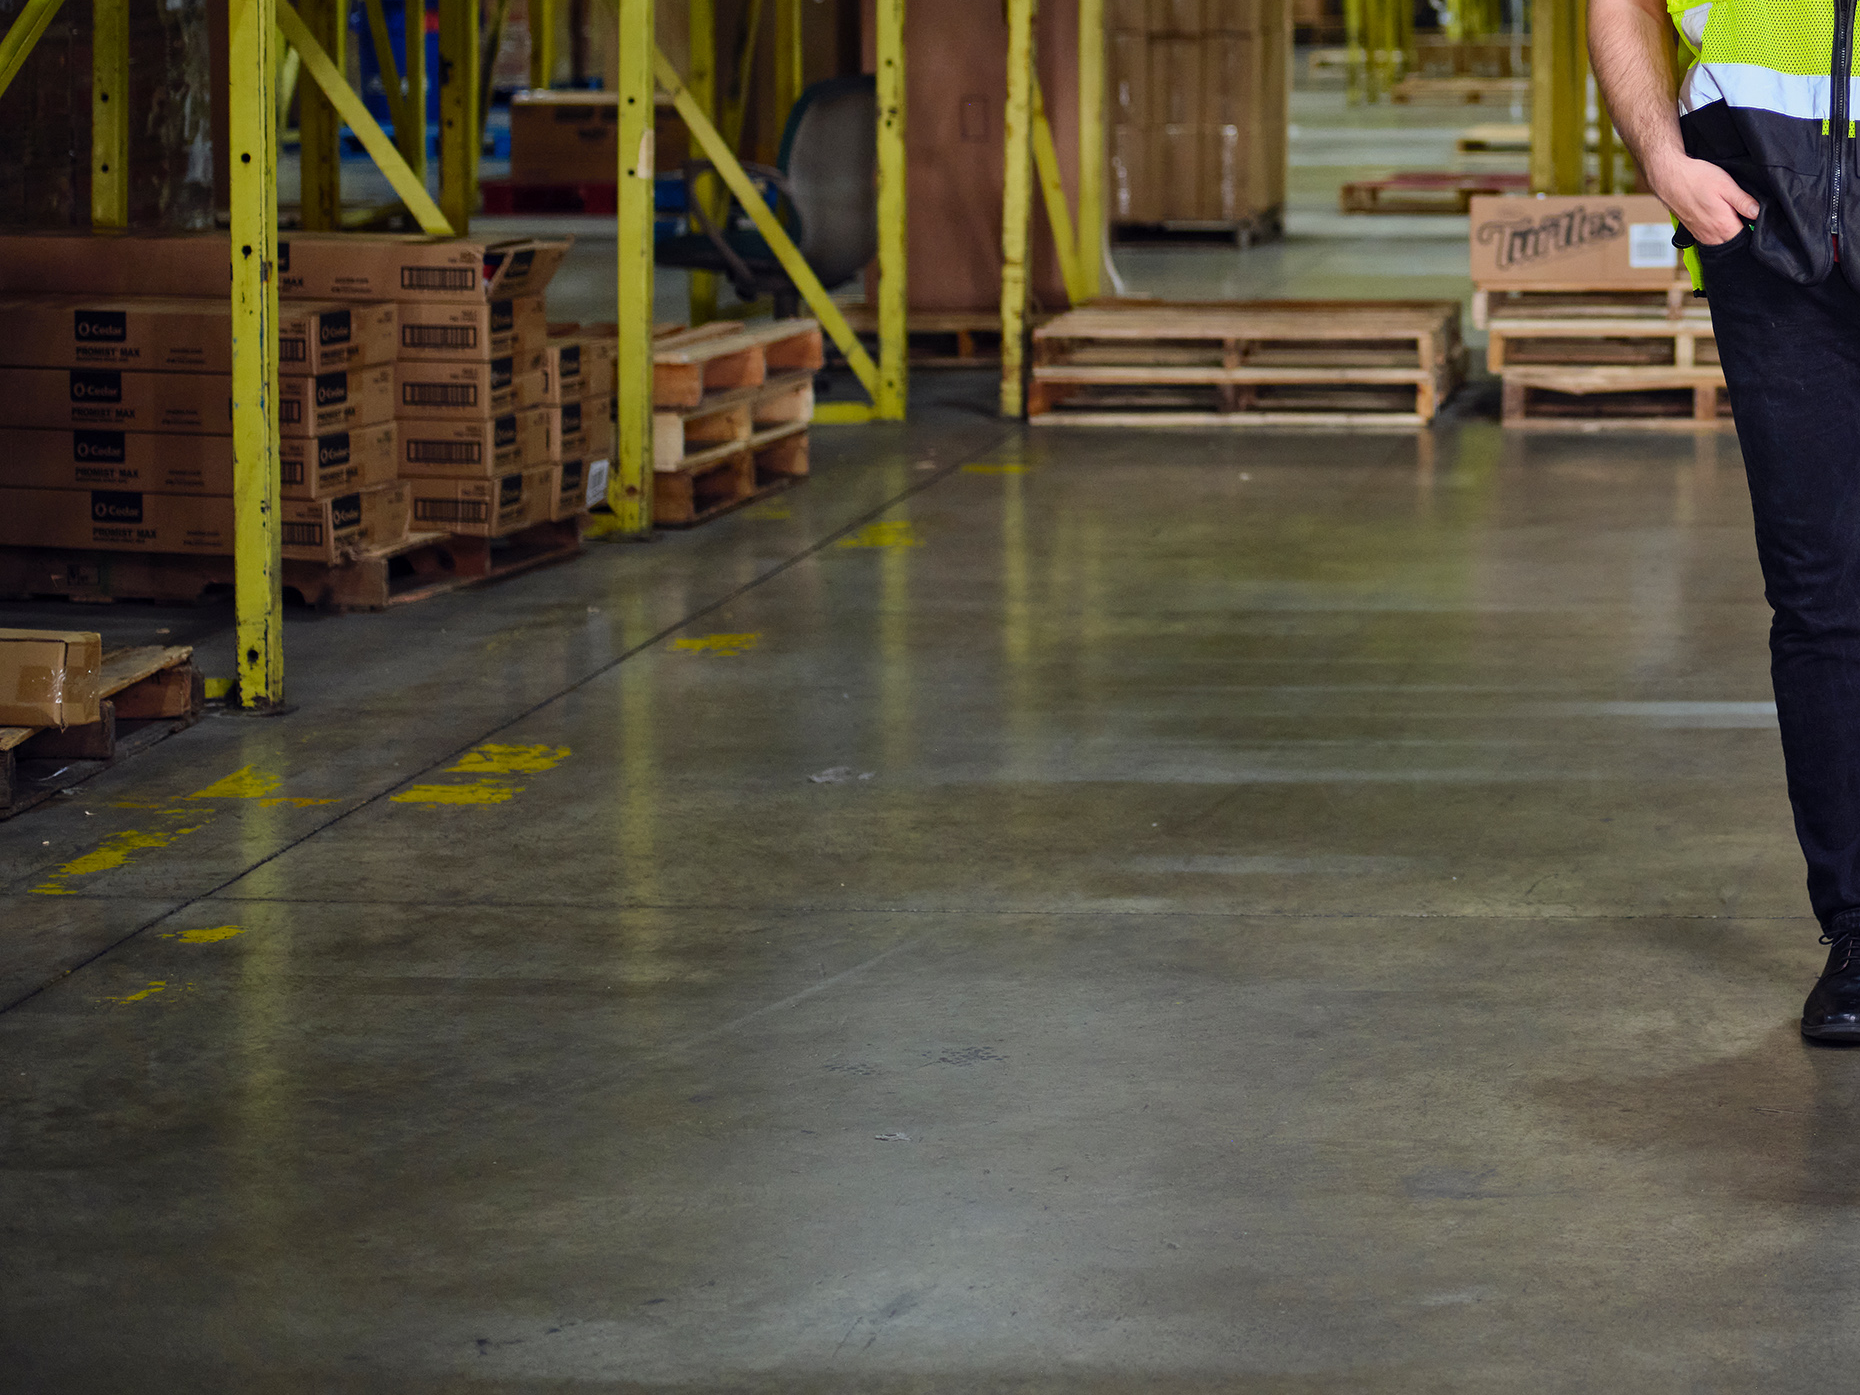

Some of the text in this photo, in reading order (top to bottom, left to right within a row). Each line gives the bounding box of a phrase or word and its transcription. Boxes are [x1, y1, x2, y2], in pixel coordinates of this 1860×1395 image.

[1476, 205, 1625, 271] Turtles
[119, 347, 140, 358] MAX
[115, 408, 136, 419] MAX
[119, 467, 139, 479] MAX
[136, 528, 157, 540] MAX
